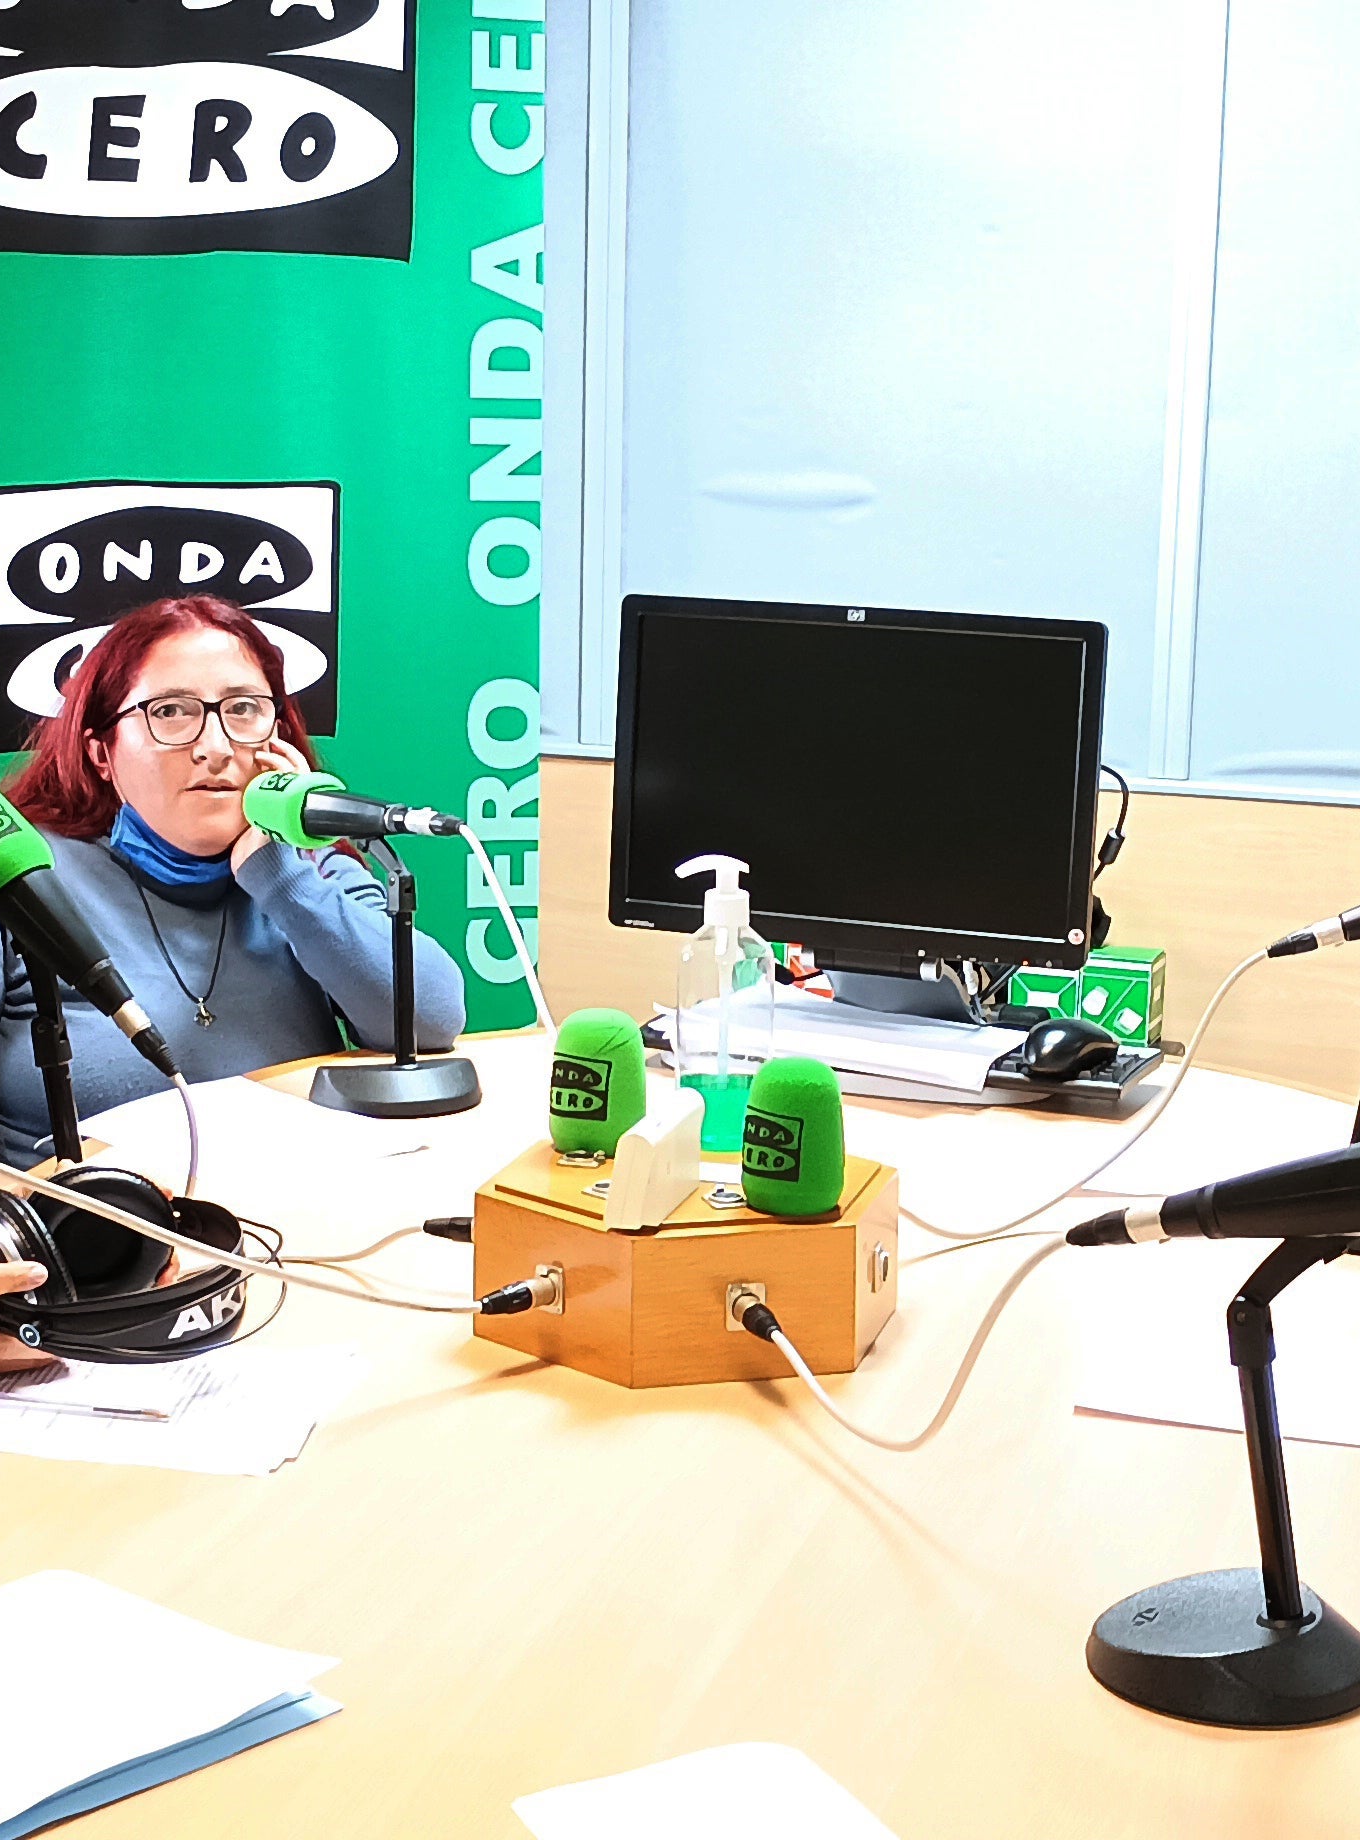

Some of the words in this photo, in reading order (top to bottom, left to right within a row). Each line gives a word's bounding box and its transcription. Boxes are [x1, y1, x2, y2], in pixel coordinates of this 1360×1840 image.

[469, 0, 546, 177] CE
[467, 222, 545, 607] ONDA
[39, 539, 285, 594] ONDA
[466, 677, 541, 985] CERO
[554, 1067, 594, 1084] NDA
[747, 1121, 786, 1142] NDA
[167, 1281, 246, 1340] AK
